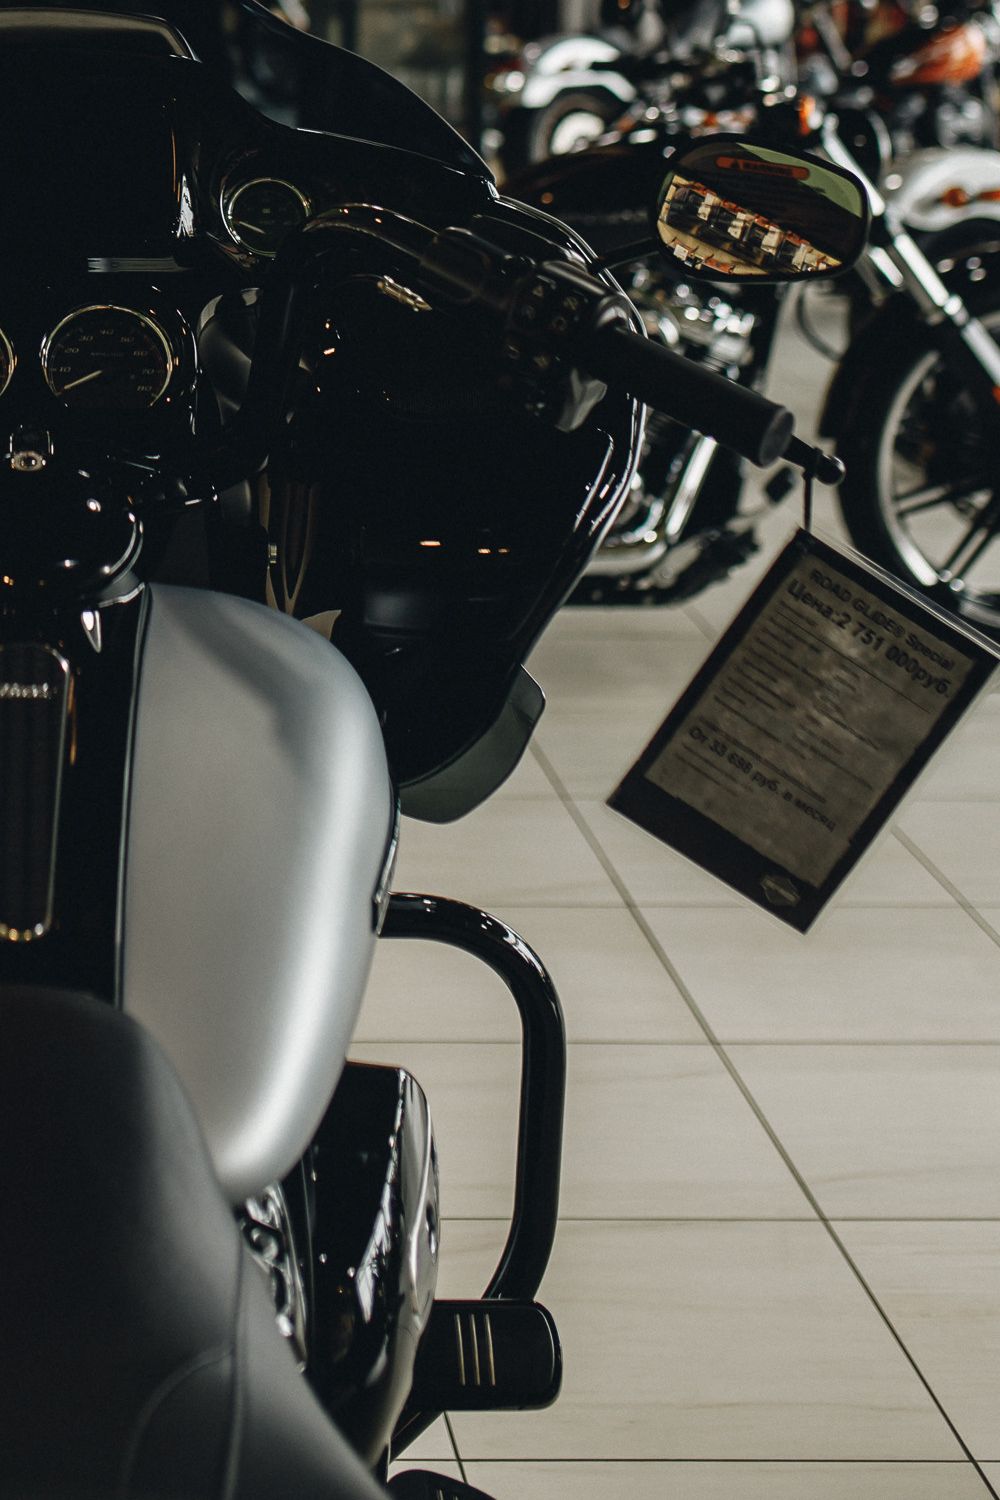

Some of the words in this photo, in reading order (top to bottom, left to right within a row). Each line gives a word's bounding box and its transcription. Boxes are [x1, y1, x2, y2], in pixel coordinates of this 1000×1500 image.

[808, 568, 853, 603] ROAD
[904, 632, 956, 673] Special
[850, 621, 885, 651] 751
